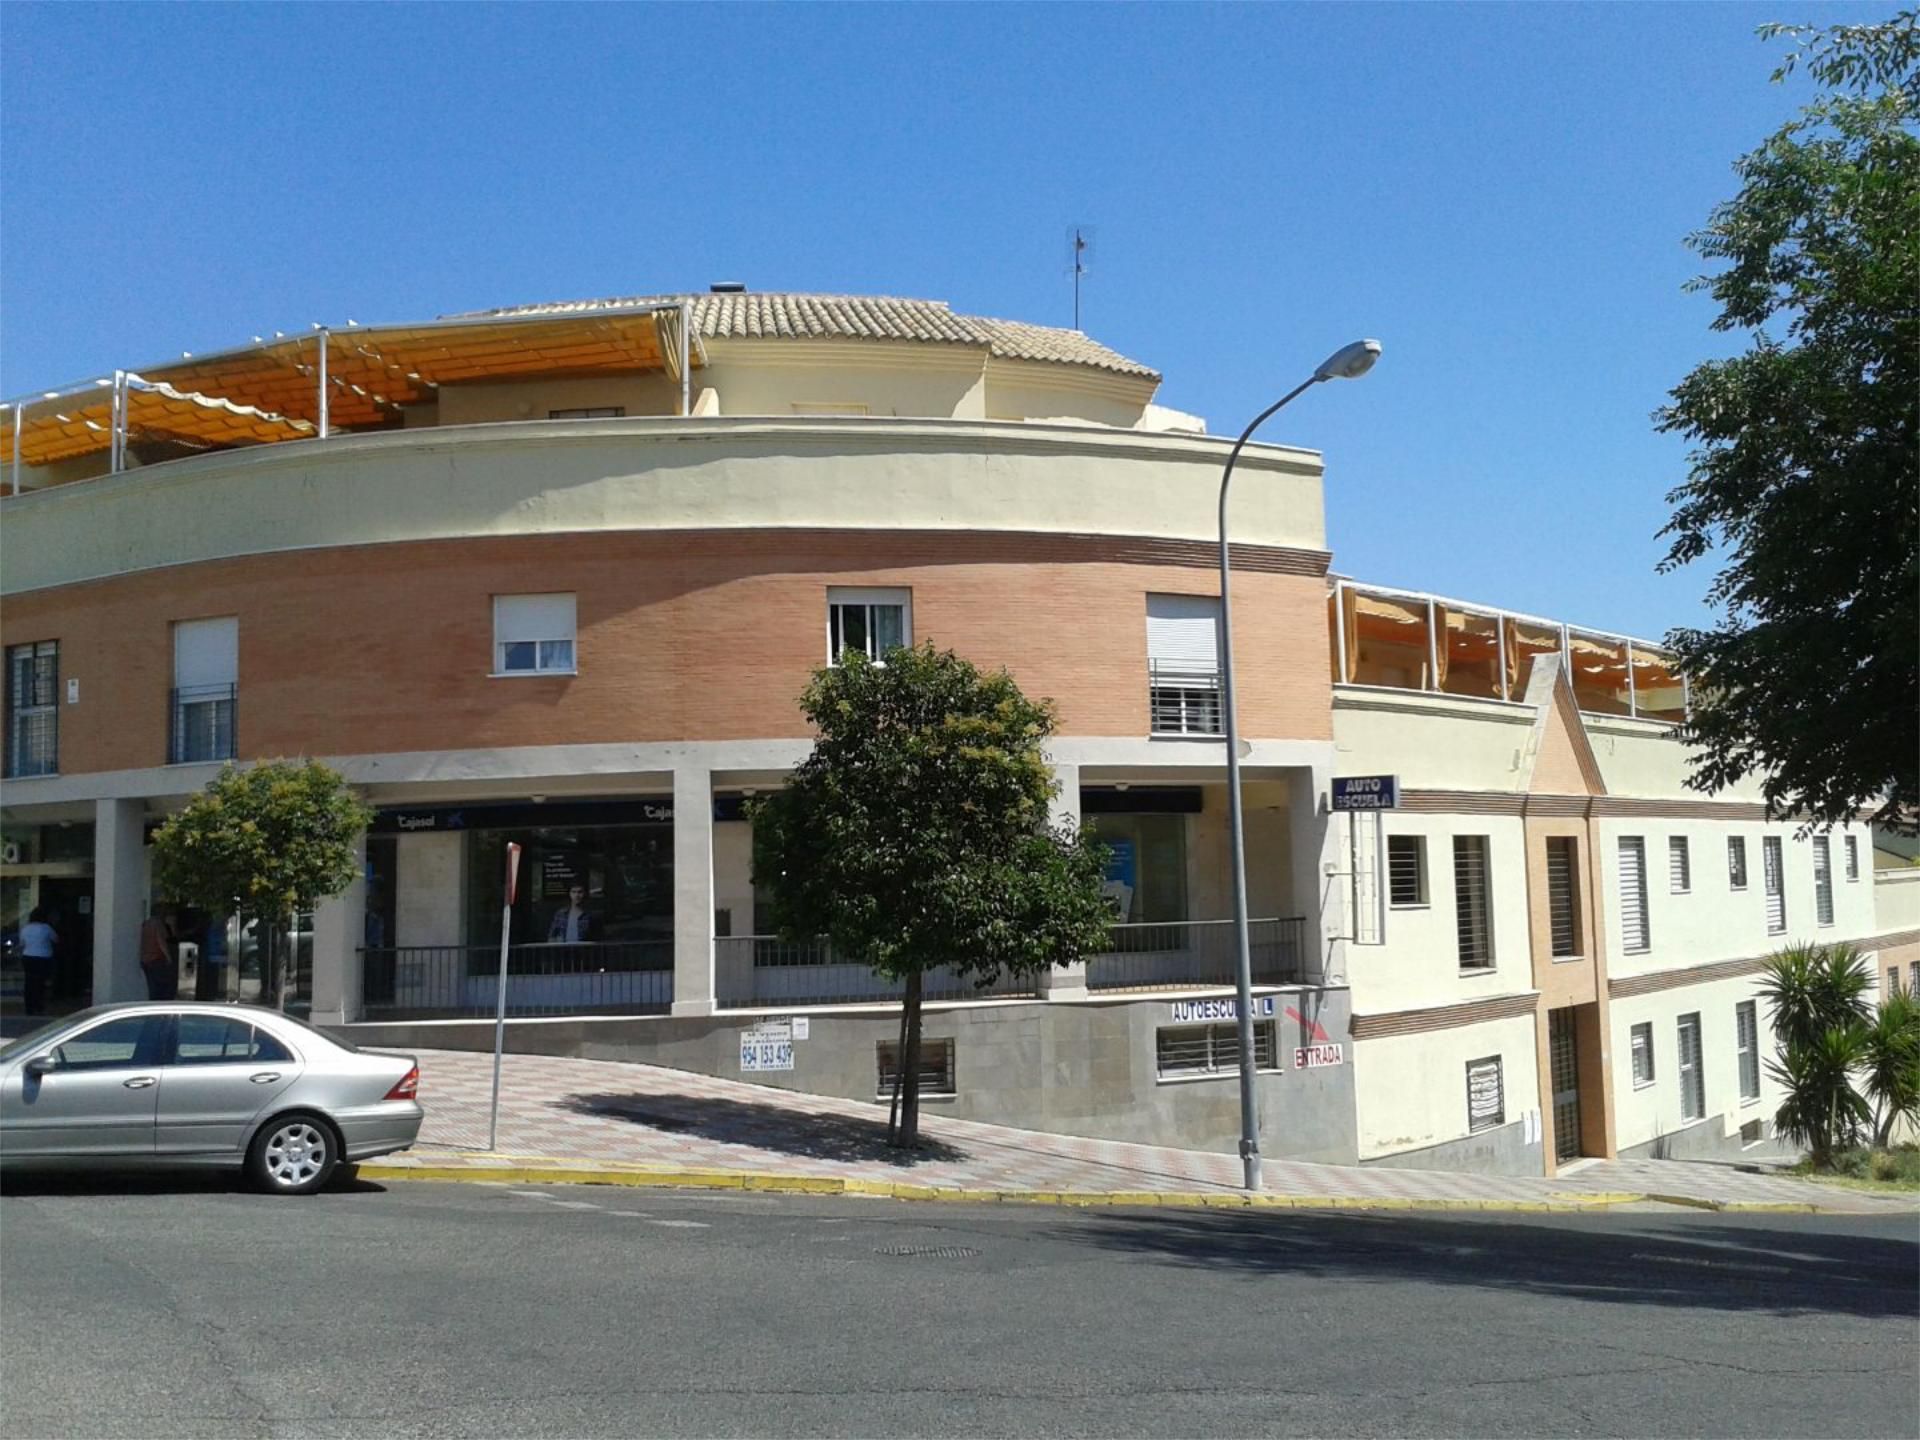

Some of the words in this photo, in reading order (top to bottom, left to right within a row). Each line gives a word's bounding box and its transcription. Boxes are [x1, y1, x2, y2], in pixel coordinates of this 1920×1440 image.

[1345, 779, 1381, 793] AUTO
[1336, 793, 1391, 808] ESCUELA
[1174, 999, 1257, 1021] AUTOESCUA
[742, 1045, 757, 1065] 954
[760, 1044, 774, 1064] 153
[776, 1043, 792, 1063] 439
[1295, 1045, 1341, 1067] ENTRADA
